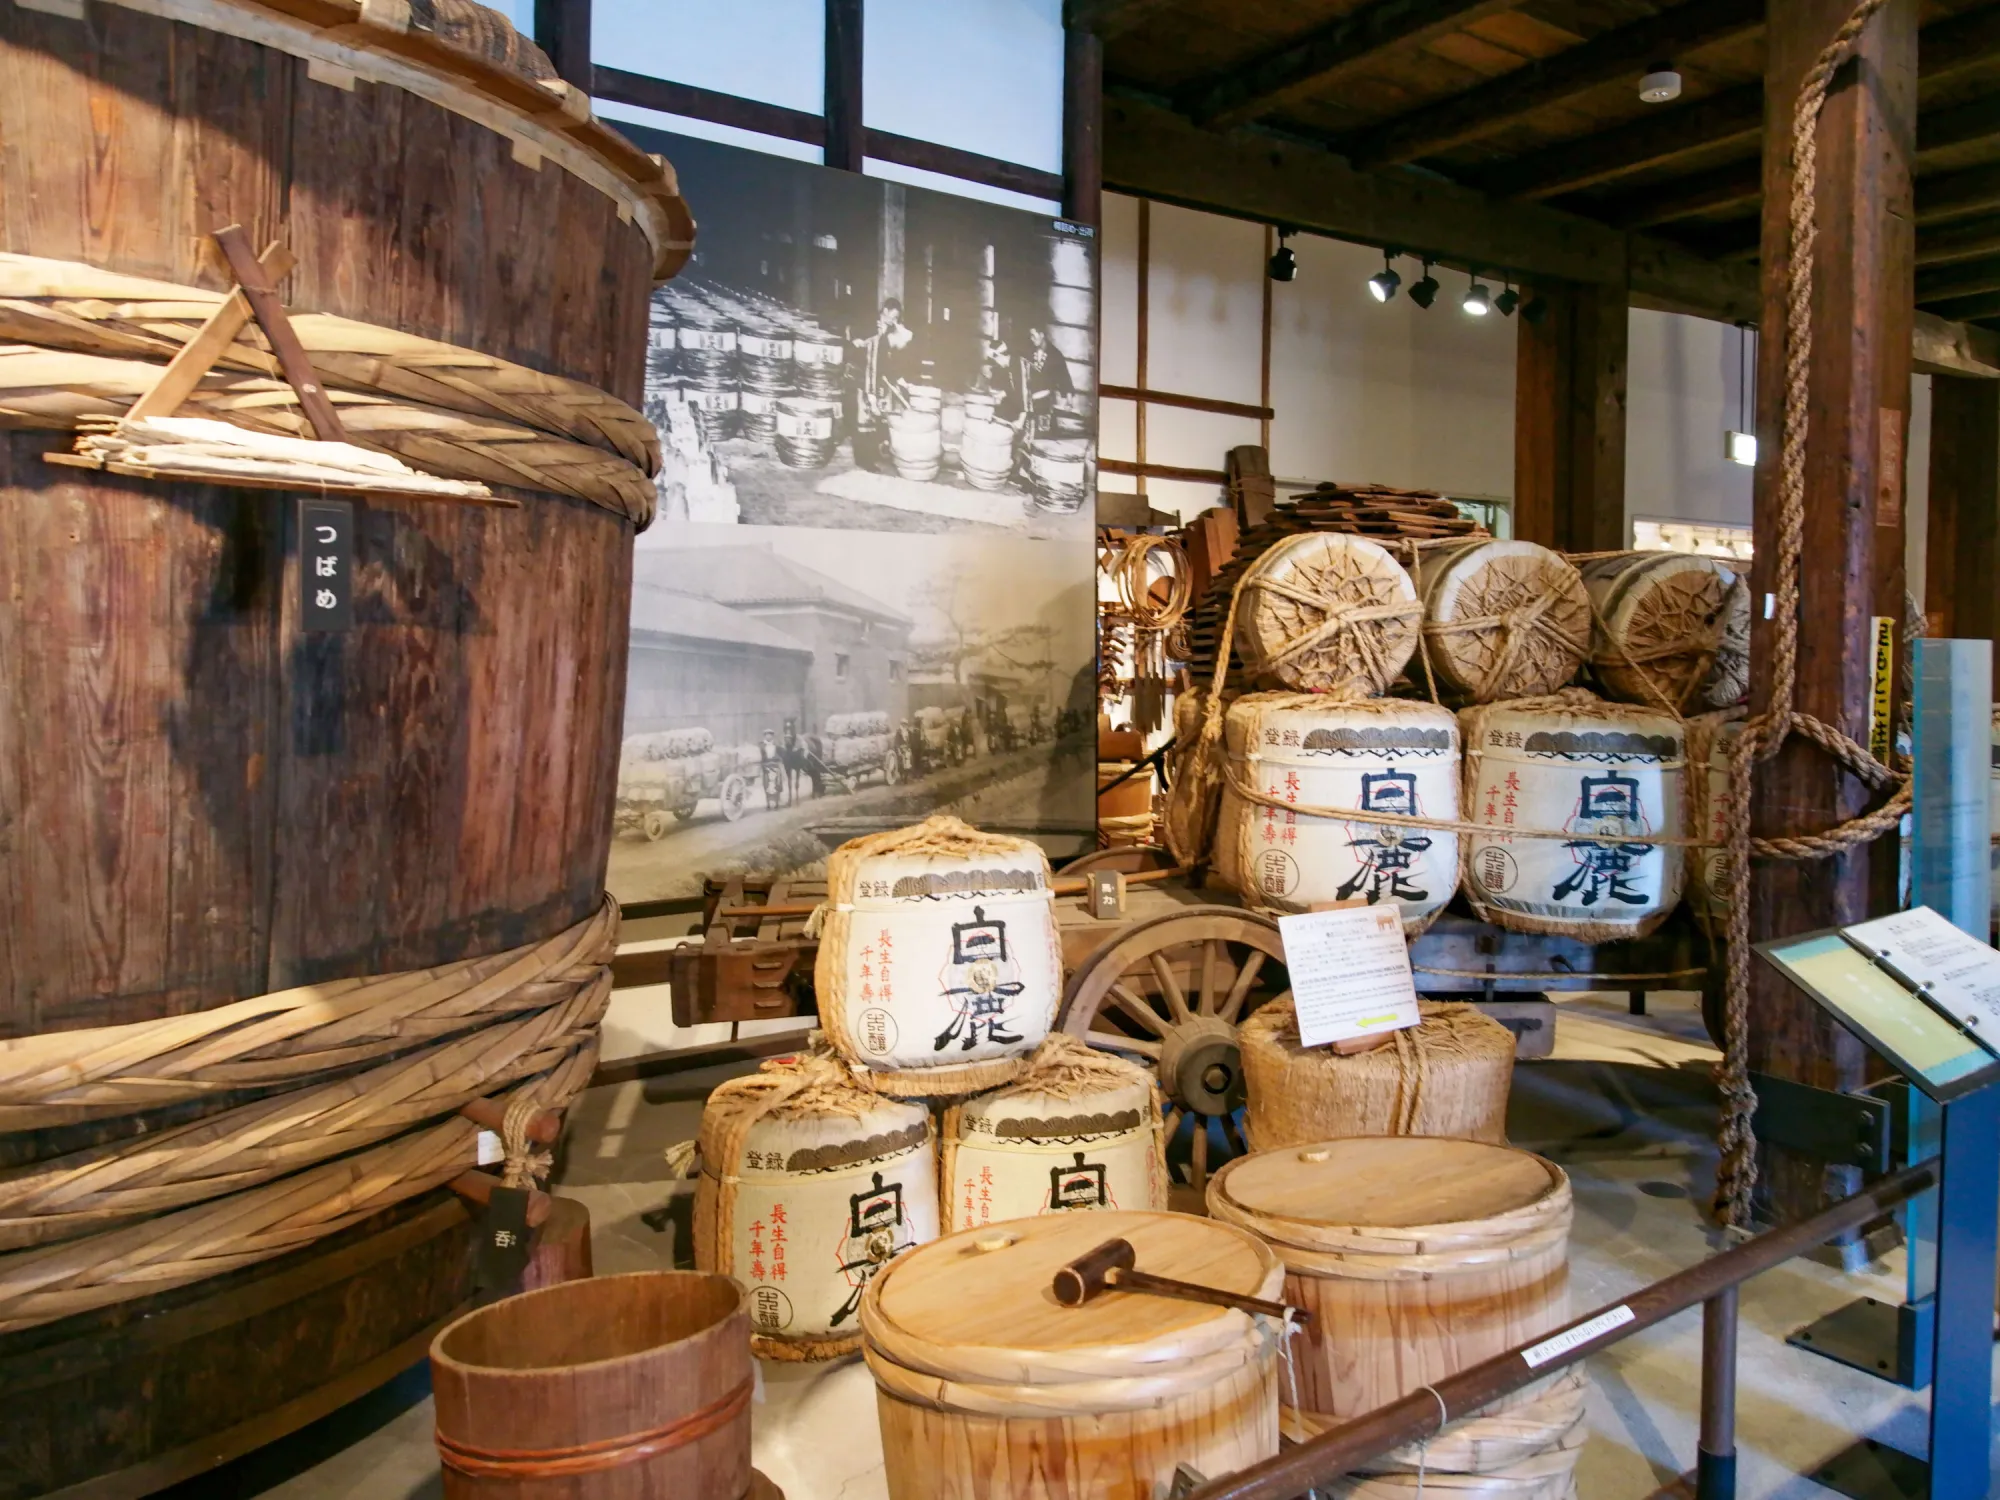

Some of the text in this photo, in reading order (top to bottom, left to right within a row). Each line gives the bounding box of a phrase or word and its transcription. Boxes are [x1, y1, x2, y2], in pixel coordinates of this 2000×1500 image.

[315, 525, 338, 609] つばめ
[1265, 728, 1300, 747] 登録
[1488, 729, 1523, 748] 登録
[934, 905, 1025, 1051] 白鹿
[964, 1113, 993, 1135] 登録
[746, 1151, 785, 1171] 登録
[978, 1165, 994, 1226] 長生自
[769, 1204, 789, 1281] 長生自得
